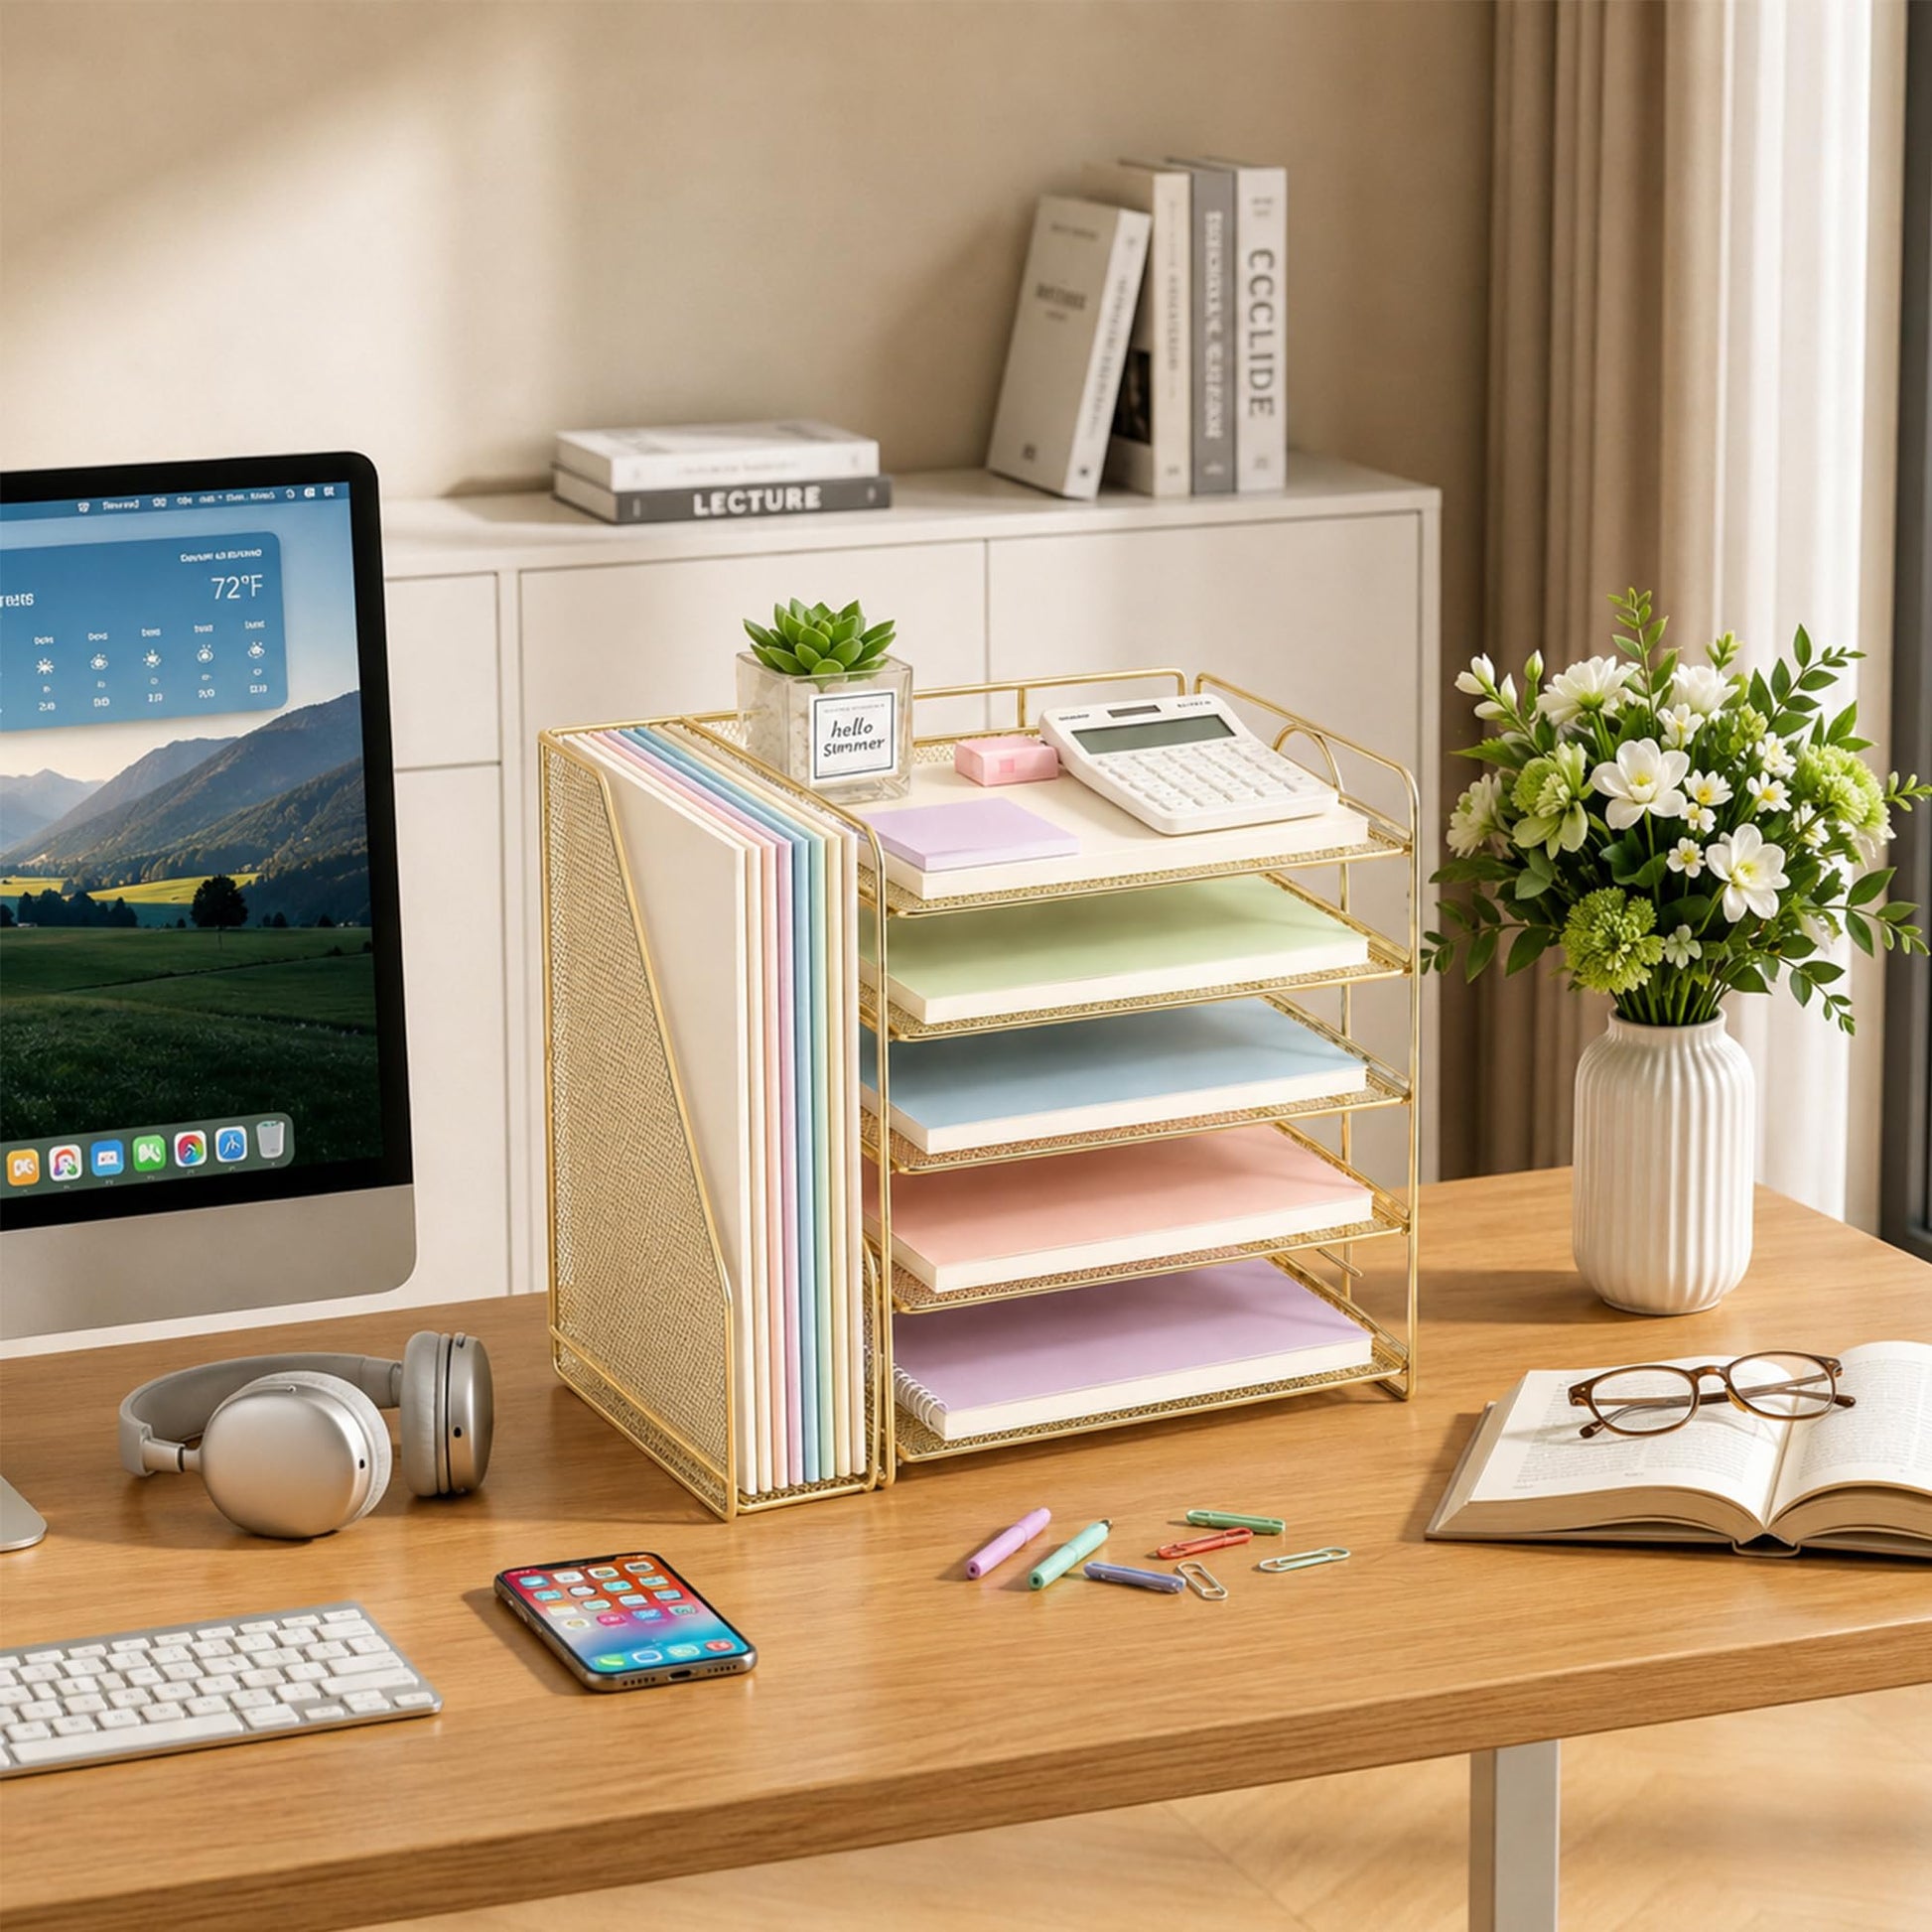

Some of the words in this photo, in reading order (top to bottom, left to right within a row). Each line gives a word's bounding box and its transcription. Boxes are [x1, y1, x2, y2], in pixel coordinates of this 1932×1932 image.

[1248, 248, 1275, 418] CCCLIDE
[693, 485, 822, 516] LECTURE
[210, 574, 263, 600] 72°F
[830, 717, 874, 738] hello
